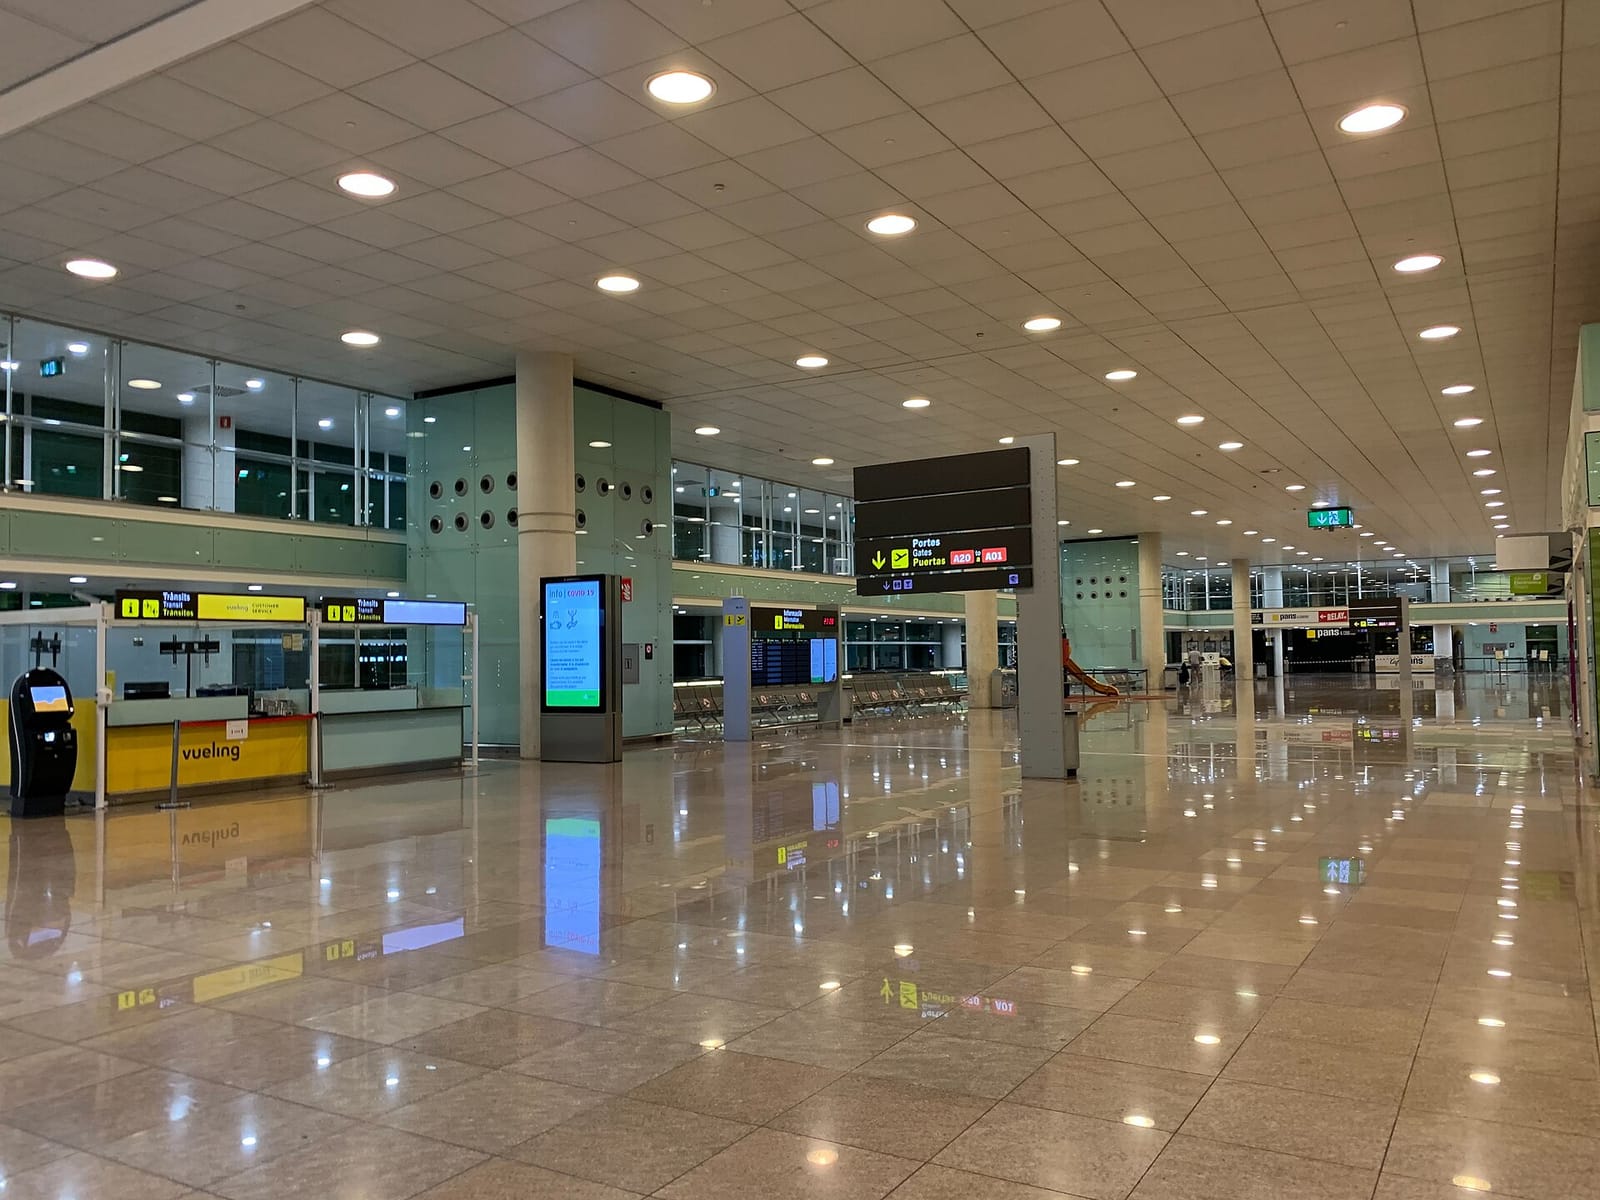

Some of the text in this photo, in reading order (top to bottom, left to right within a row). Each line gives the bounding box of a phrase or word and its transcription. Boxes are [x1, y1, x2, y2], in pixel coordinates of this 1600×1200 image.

[912, 538, 941, 548] Portes
[912, 548, 933, 557] Gates
[953, 553, 971, 563] A20
[985, 551, 1003, 561] A01
[912, 557, 946, 567] Puertas
[1280, 613, 1297, 621] pans
[1317, 627, 1340, 637] pans
[182, 741, 240, 761] vueling
